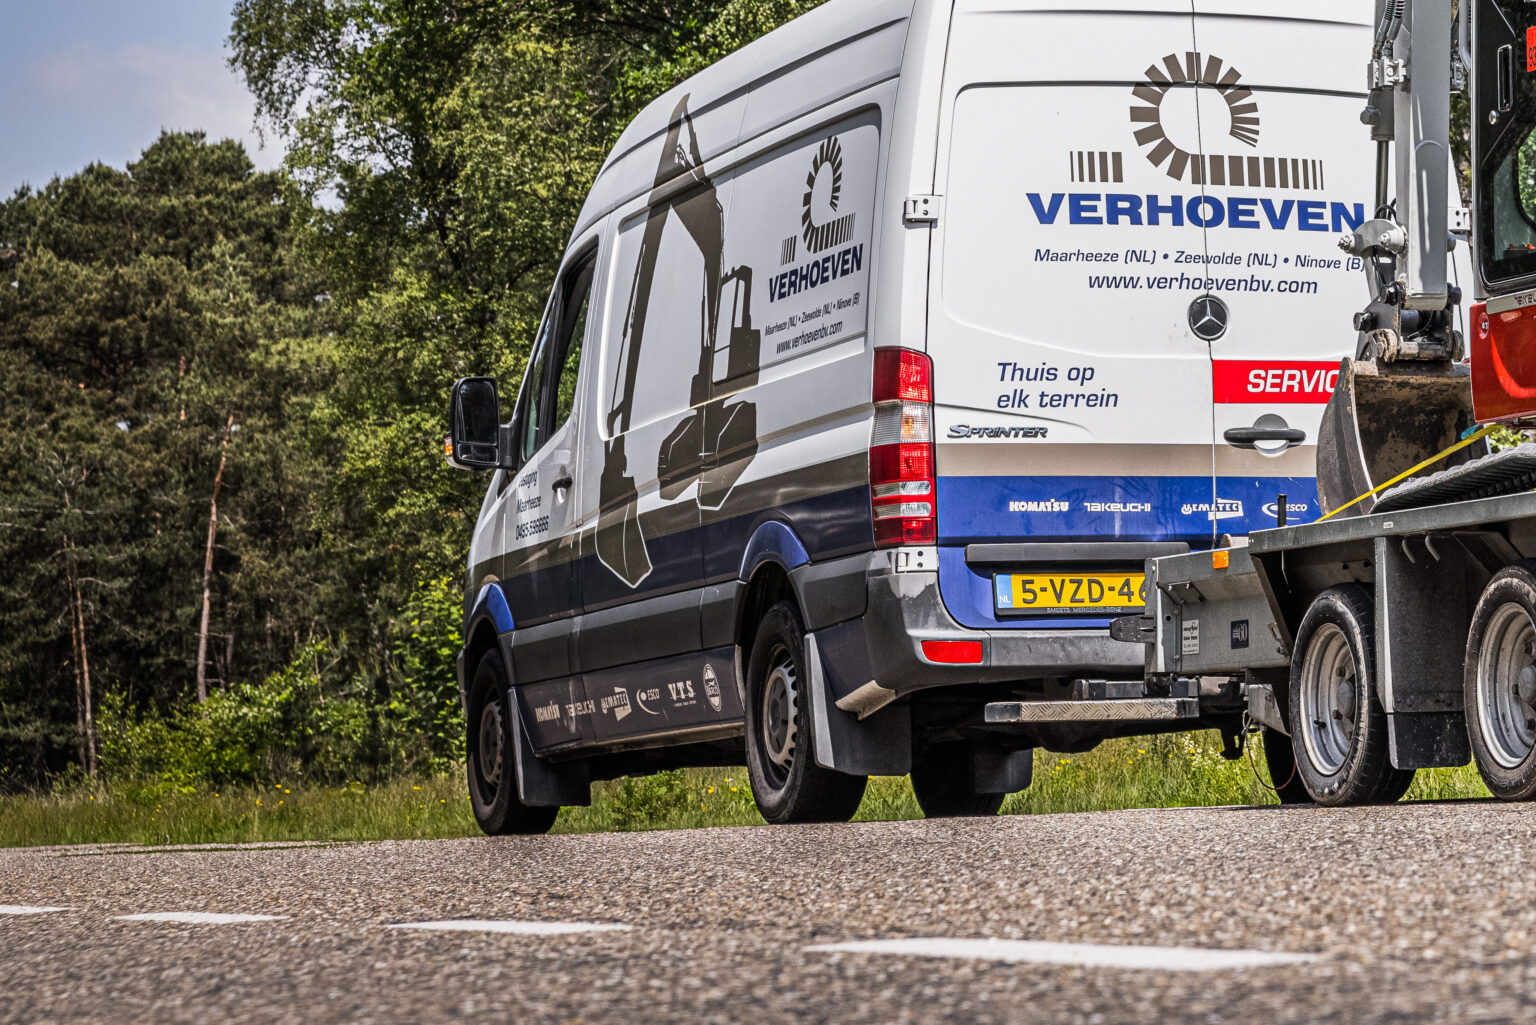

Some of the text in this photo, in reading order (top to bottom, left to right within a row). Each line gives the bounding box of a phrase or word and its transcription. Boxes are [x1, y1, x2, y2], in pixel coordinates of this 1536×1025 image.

[1025, 193, 1365, 233] VERHOEVEN
[1034, 249, 1119, 263] Maarheeze
[1124, 250, 1157, 265] (NL)
[1174, 251, 1242, 266] Zeewolde
[1247, 253, 1278, 268] (NL)
[1295, 255, 1341, 269] Ninove
[769, 243, 863, 303] VERHOEVEN
[1088, 273, 1318, 294] www.verhoevenbv.com
[765, 321, 787, 336] Maarheeze
[801, 307, 821, 324] Zeewolde
[836, 297, 851, 311] Ninove
[776, 321, 843, 354] www.verhoevenbv.com
[997, 362, 1095, 386] Thuis op
[997, 389, 1119, 409] elk terrein
[946, 424, 1049, 439] SPRINTER
[1009, 498, 1069, 512] KOMATSU
[1000, 595, 1011, 603] NL
[647, 688, 659, 701] ESCO
